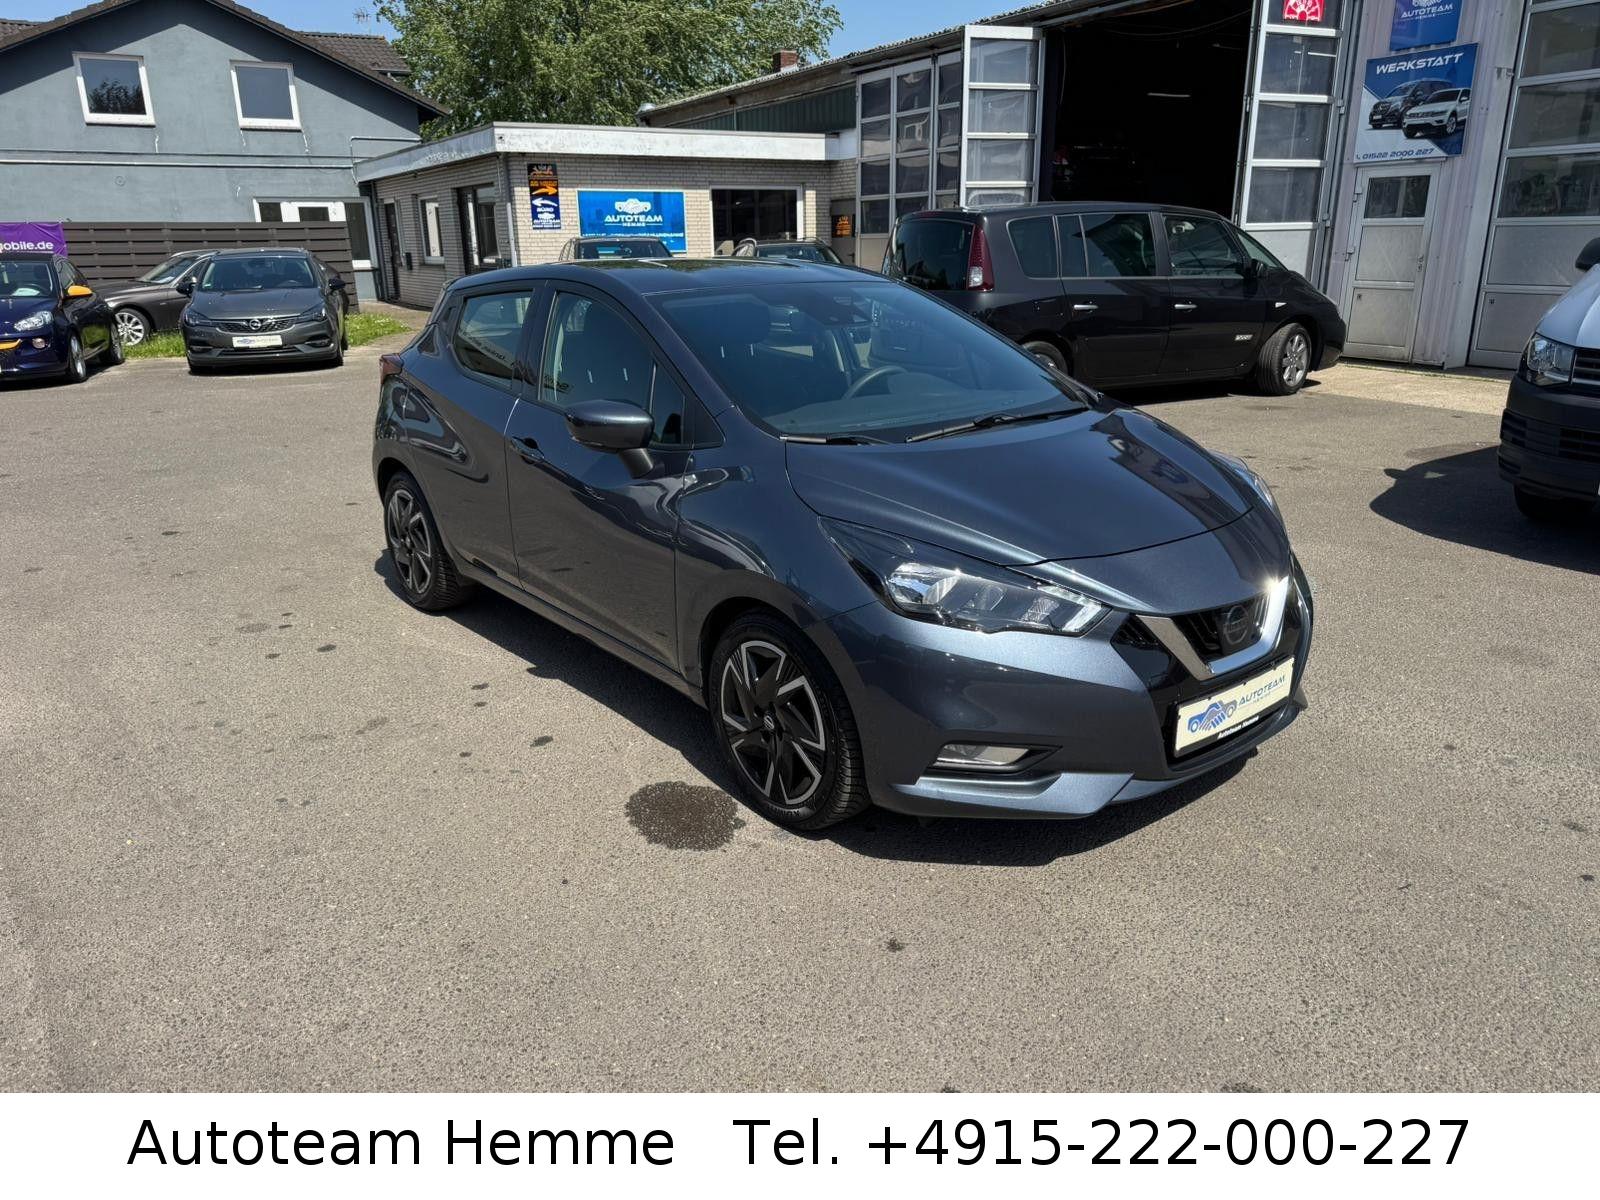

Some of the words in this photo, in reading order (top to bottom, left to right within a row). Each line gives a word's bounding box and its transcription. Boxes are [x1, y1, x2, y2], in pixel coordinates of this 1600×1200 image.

[1400, 3, 1454, 18] AUTOTEAM
[1376, 52, 1464, 75] WERKSTATT
[1390, 149, 1414, 158] 2000
[603, 214, 663, 223] AUTOTEAM
[0, 241, 54, 251] obile.de
[1240, 676, 1285, 705] AUTOTEAM
